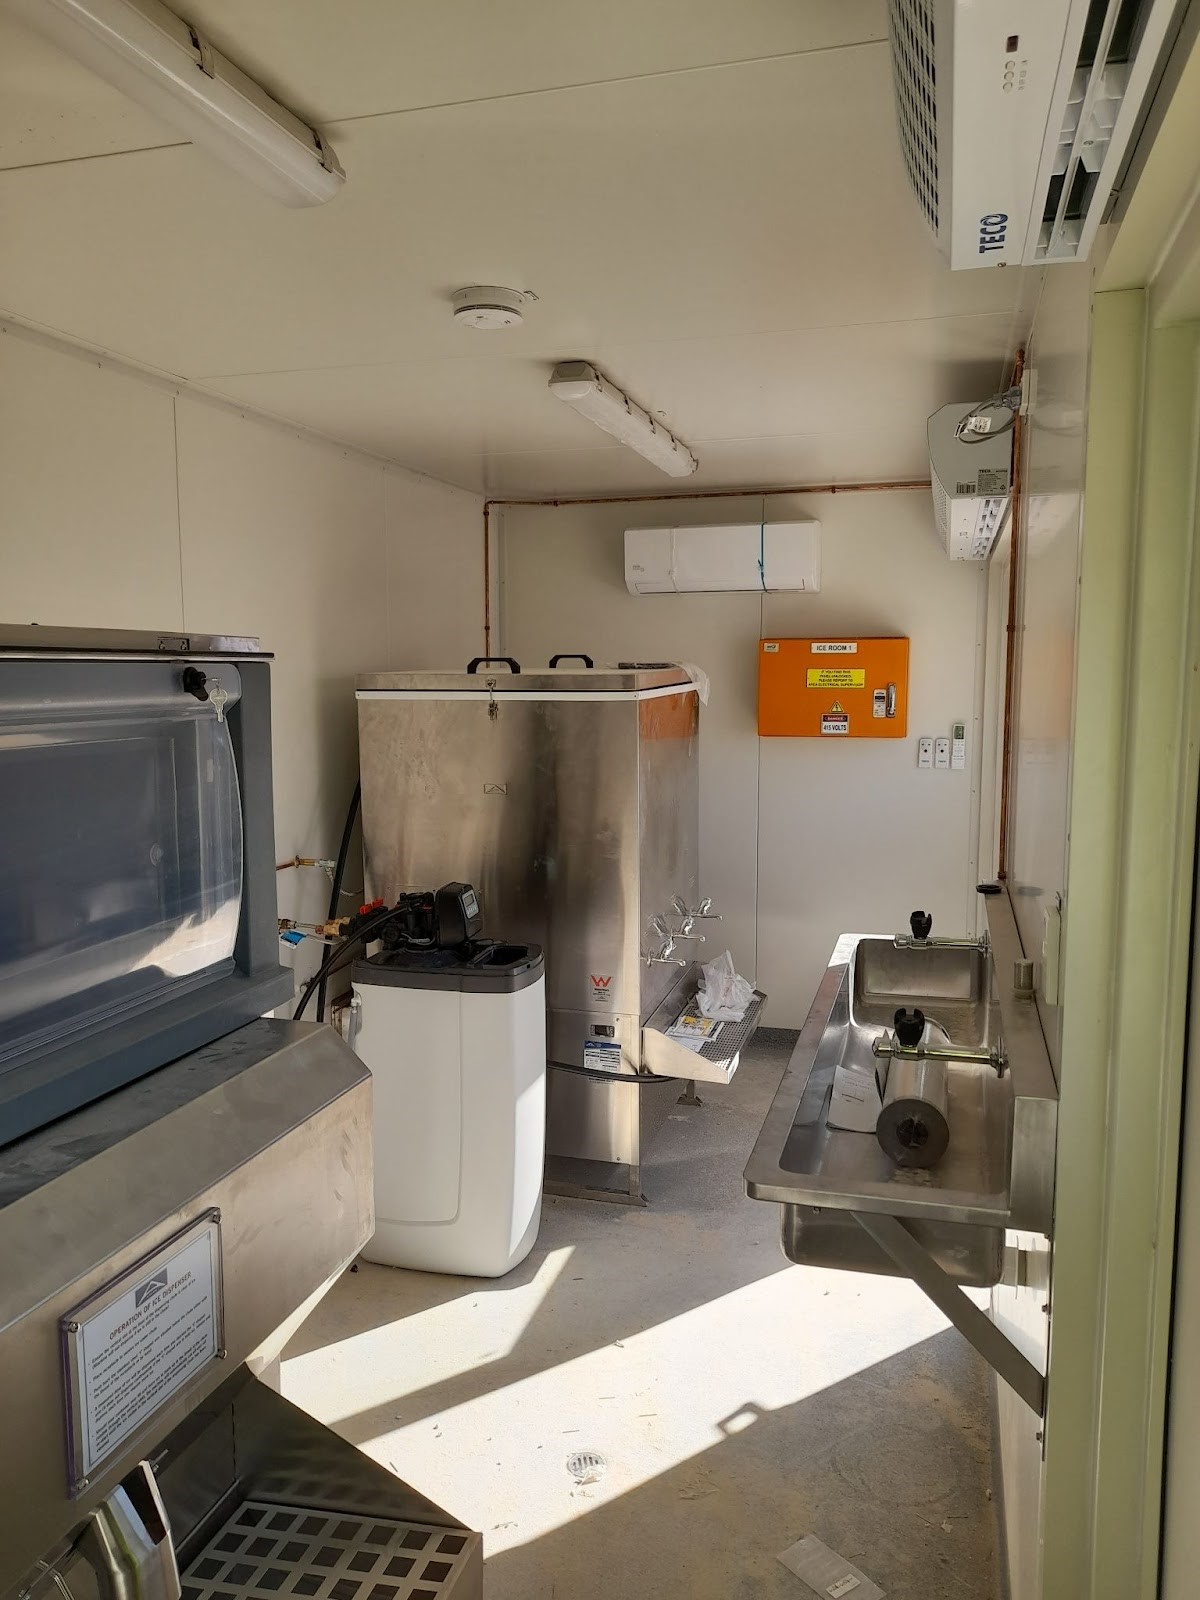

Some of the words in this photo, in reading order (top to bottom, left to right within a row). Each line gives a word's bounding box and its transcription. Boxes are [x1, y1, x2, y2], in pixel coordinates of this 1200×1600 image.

[978, 213, 1009, 254] TECO
[109, 1308, 141, 1340] OPERATION
[143, 1302, 150, 1313] OF
[152, 1294, 161, 1306] ICE
[162, 1269, 191, 1298] DISPENSER
